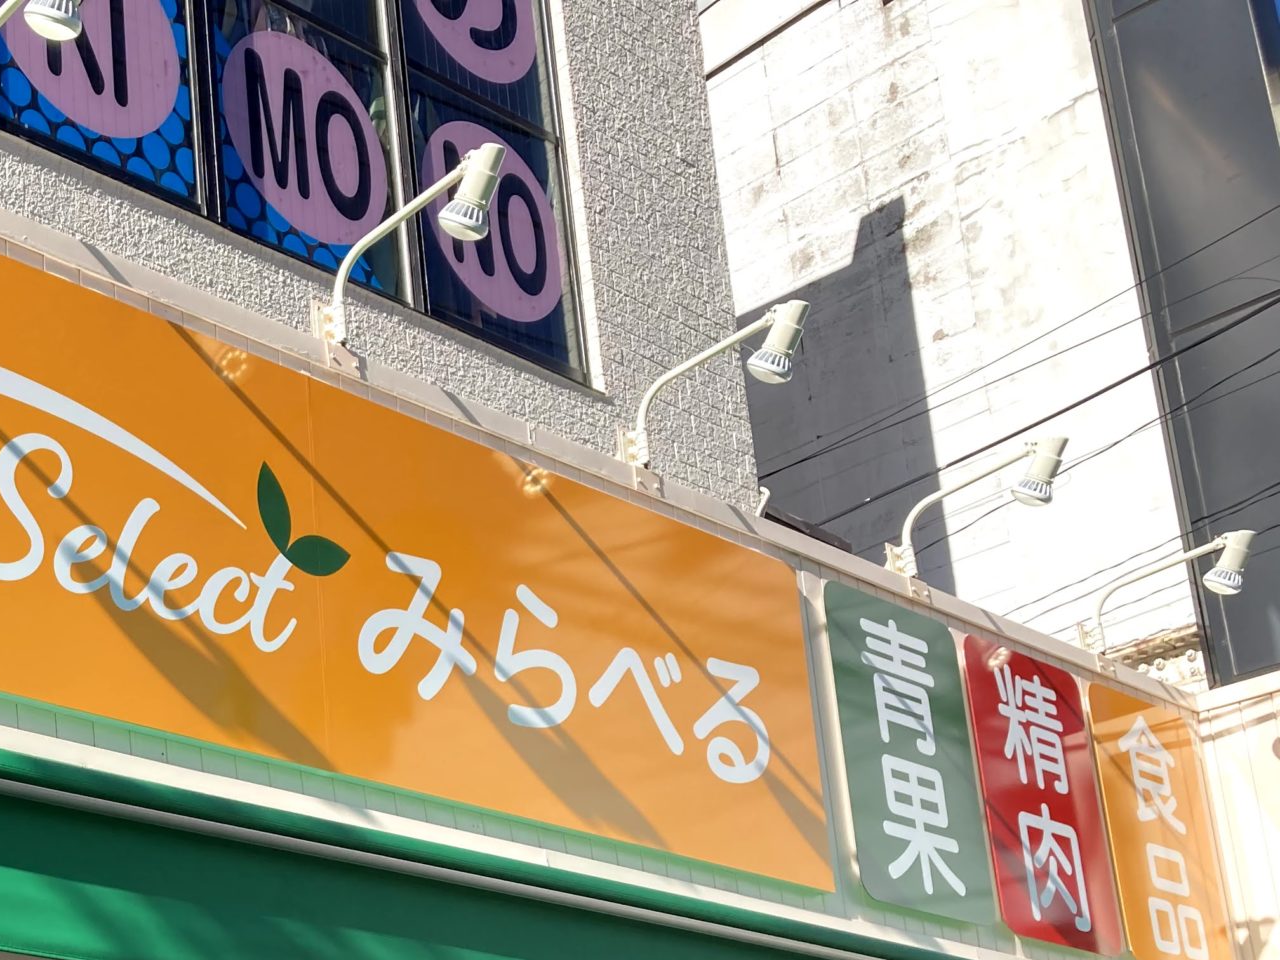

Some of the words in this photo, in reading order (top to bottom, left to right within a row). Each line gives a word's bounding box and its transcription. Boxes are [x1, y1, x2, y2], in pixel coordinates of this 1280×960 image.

[244, 47, 370, 221] MO
[357, 551, 772, 784] みらべる
[859, 616, 967, 898] 青果
[994, 664, 1092, 933] 精肉
